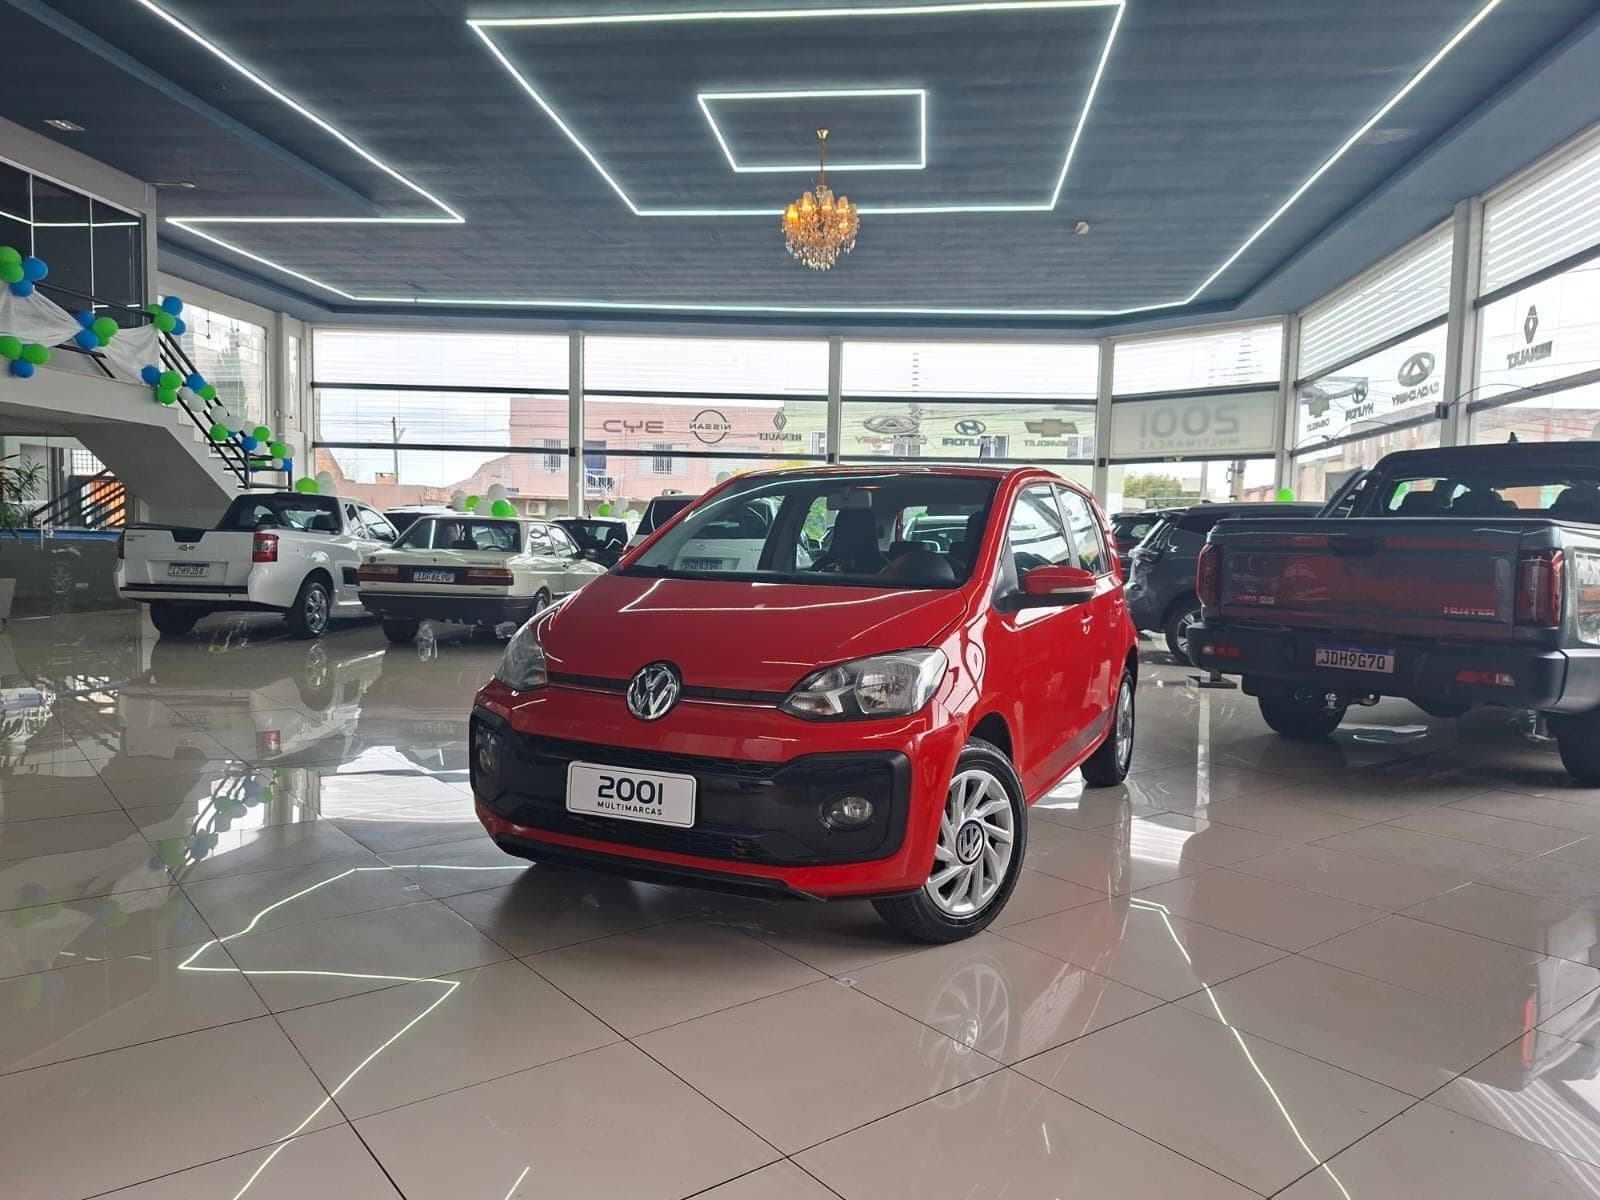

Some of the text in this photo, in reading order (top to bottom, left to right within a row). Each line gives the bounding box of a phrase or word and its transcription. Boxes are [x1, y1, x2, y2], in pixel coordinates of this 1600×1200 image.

[1320, 650, 1386, 670] JDH9G70
[597, 775, 663, 805] 2001
[597, 800, 663, 816] MULTIMARCAS
